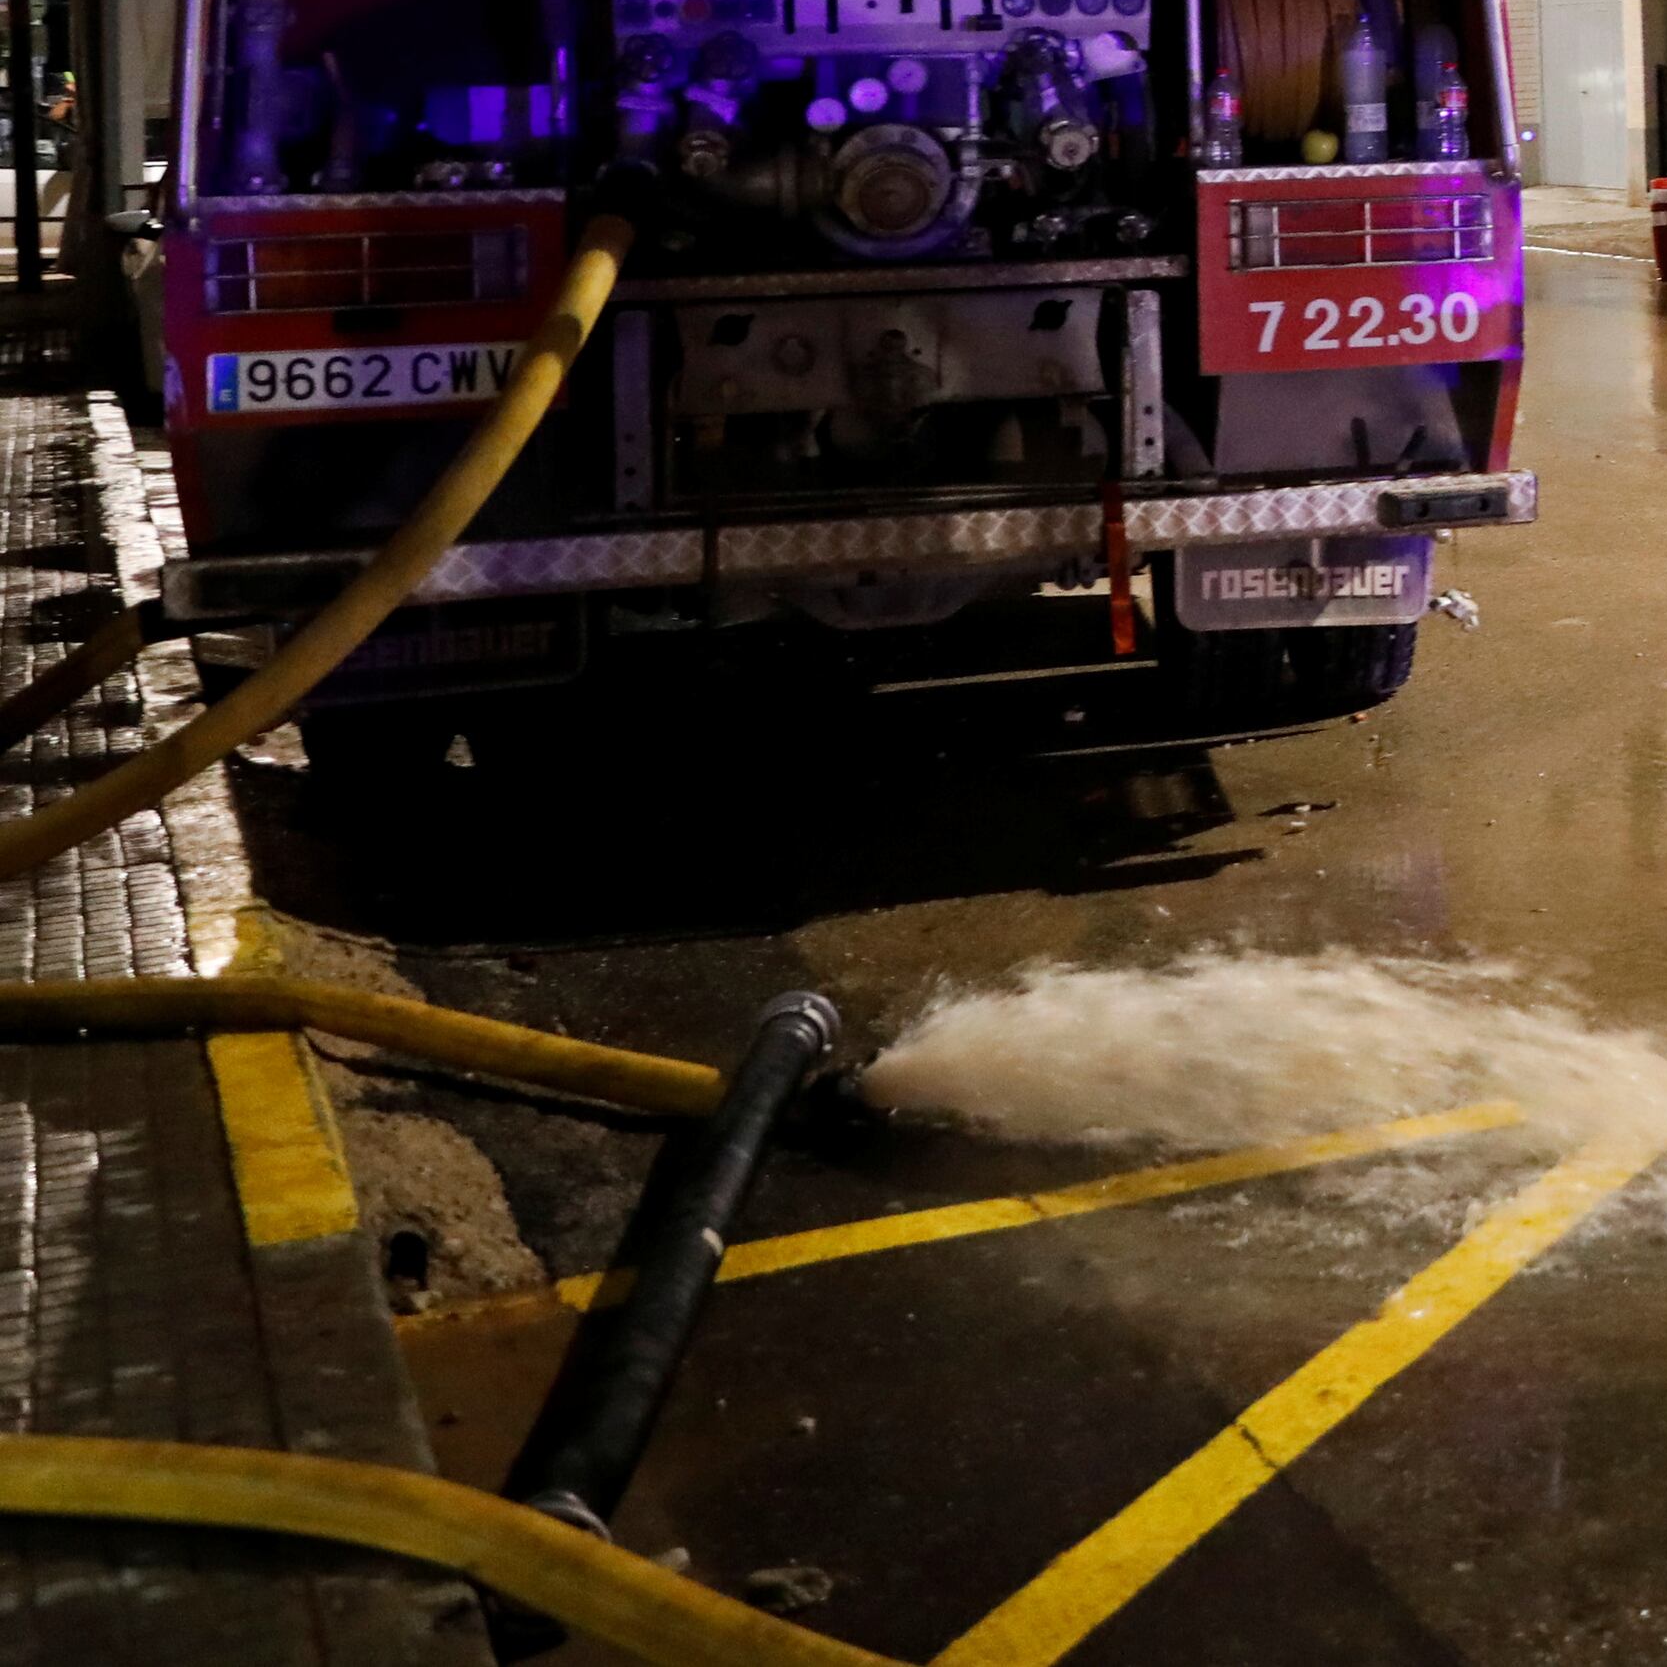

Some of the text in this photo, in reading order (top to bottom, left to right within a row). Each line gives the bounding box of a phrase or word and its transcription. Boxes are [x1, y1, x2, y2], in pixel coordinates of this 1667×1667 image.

[1248, 291, 1480, 353] 7 22.30
[247, 348, 515, 403] 9662 CWV
